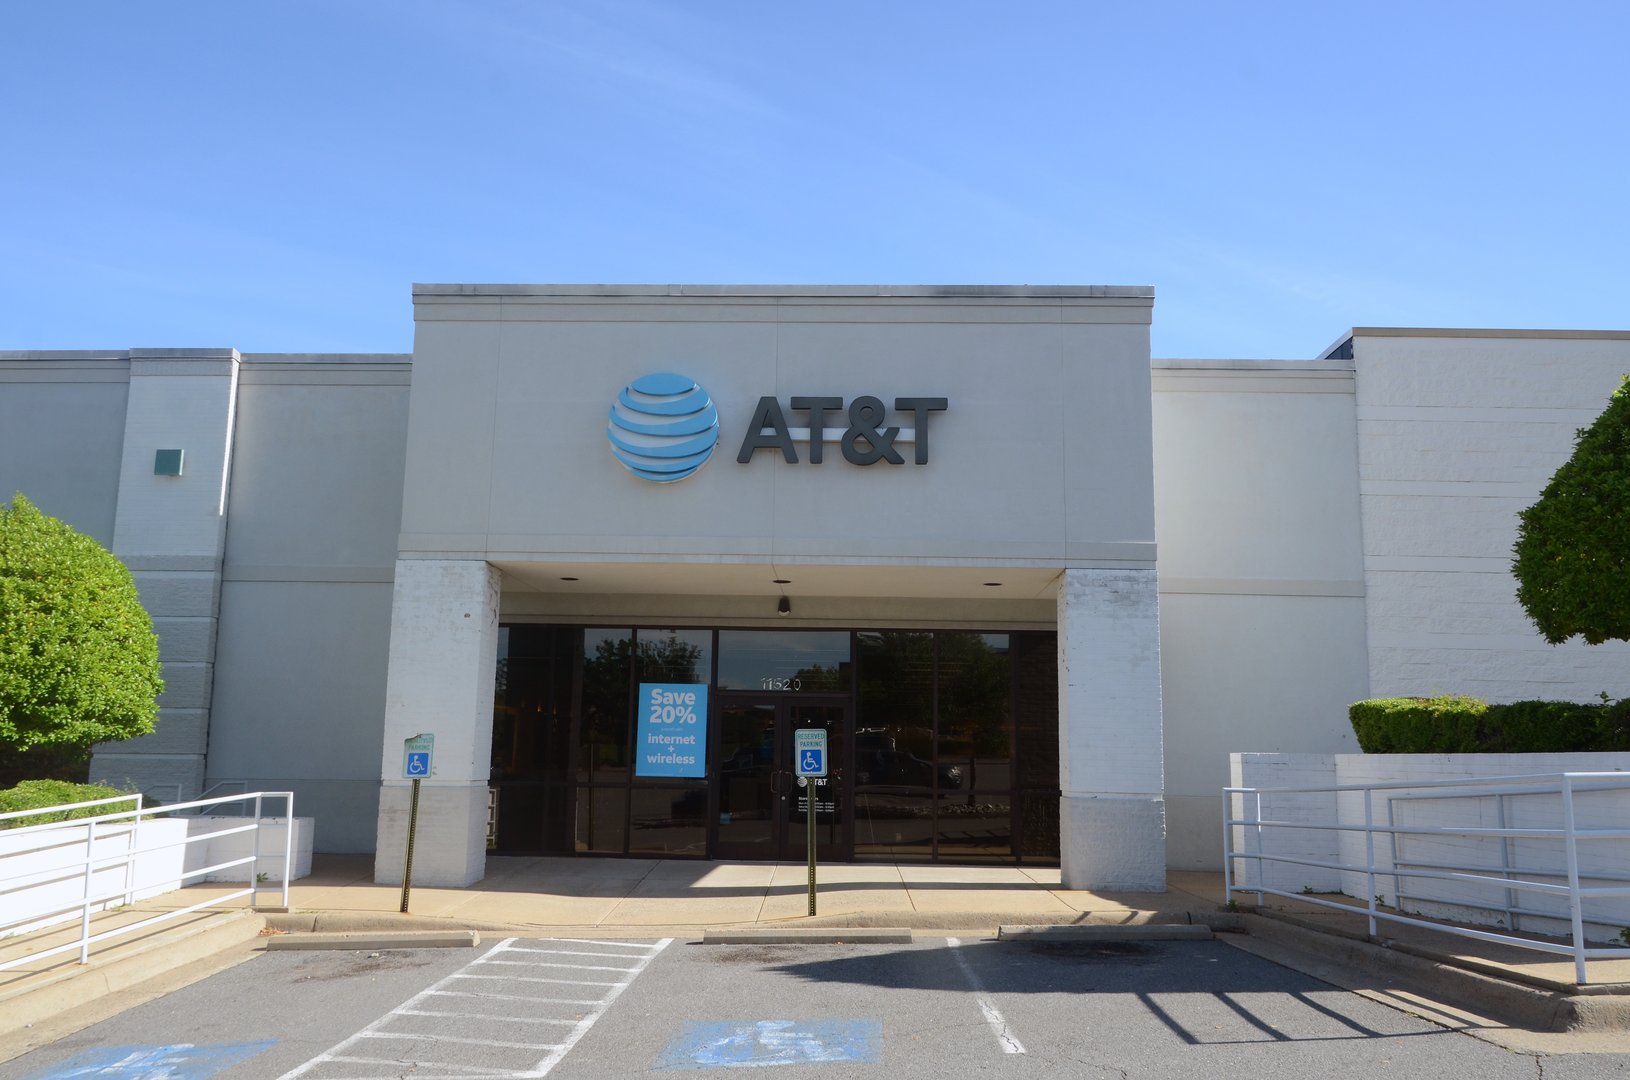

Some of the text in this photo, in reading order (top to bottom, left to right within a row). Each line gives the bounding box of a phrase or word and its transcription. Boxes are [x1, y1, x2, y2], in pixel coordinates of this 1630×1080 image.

[736, 395, 948, 466] AT&T
[761, 677, 801, 691] 11520
[651, 688, 696, 705] Save
[650, 705, 697, 724] 20%
[647, 733, 696, 744] internet
[647, 753, 696, 765] wireless
